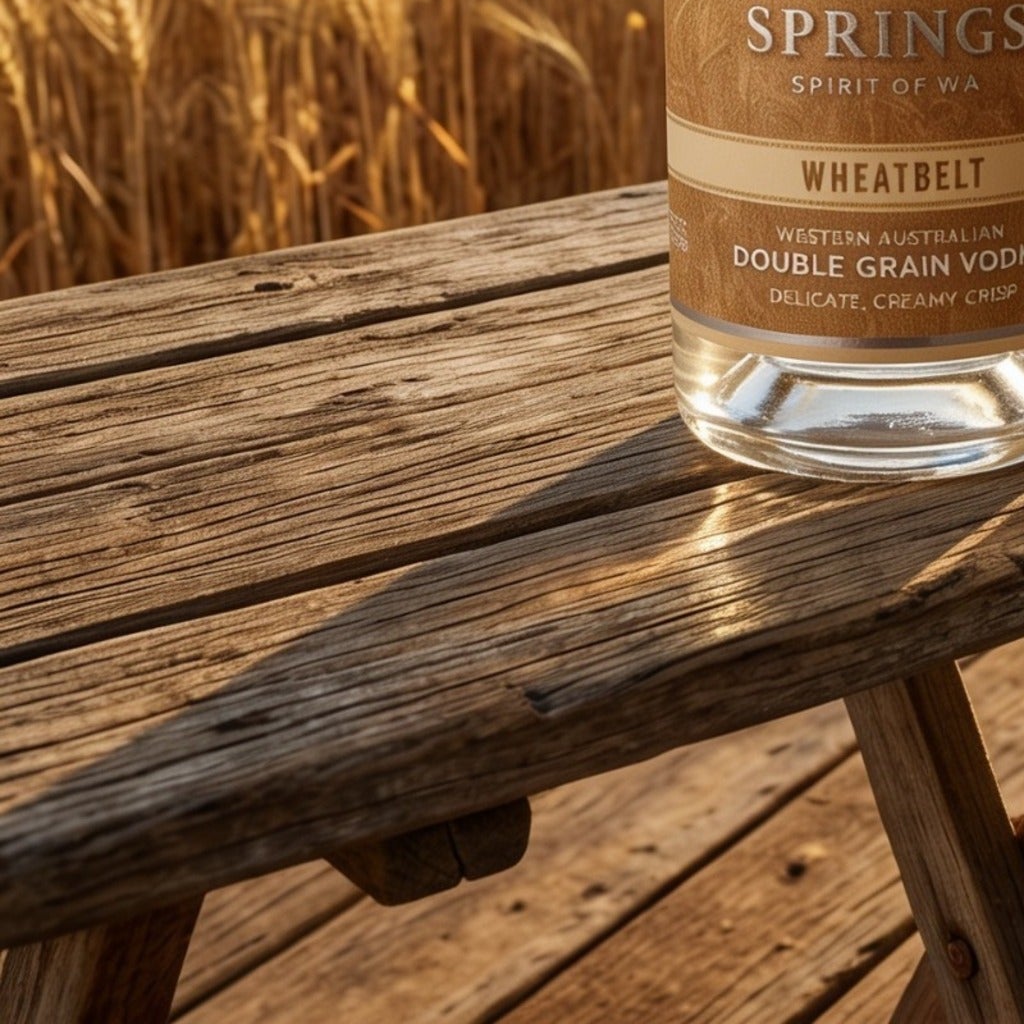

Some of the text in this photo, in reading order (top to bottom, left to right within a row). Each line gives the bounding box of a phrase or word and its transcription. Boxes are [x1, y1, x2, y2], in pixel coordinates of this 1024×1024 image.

[792, 75, 979, 95] SPIRIT OF WA
[801, 157, 985, 193] WHEATBELT
[776, 224, 1005, 246] WESTERN AUSTRALIAN
[734, 244, 844, 278] DOUBLE
[856, 253, 950, 278] GRAIN
[873, 291, 958, 309] CREAMY
[965, 283, 1018, 305] CRISP
